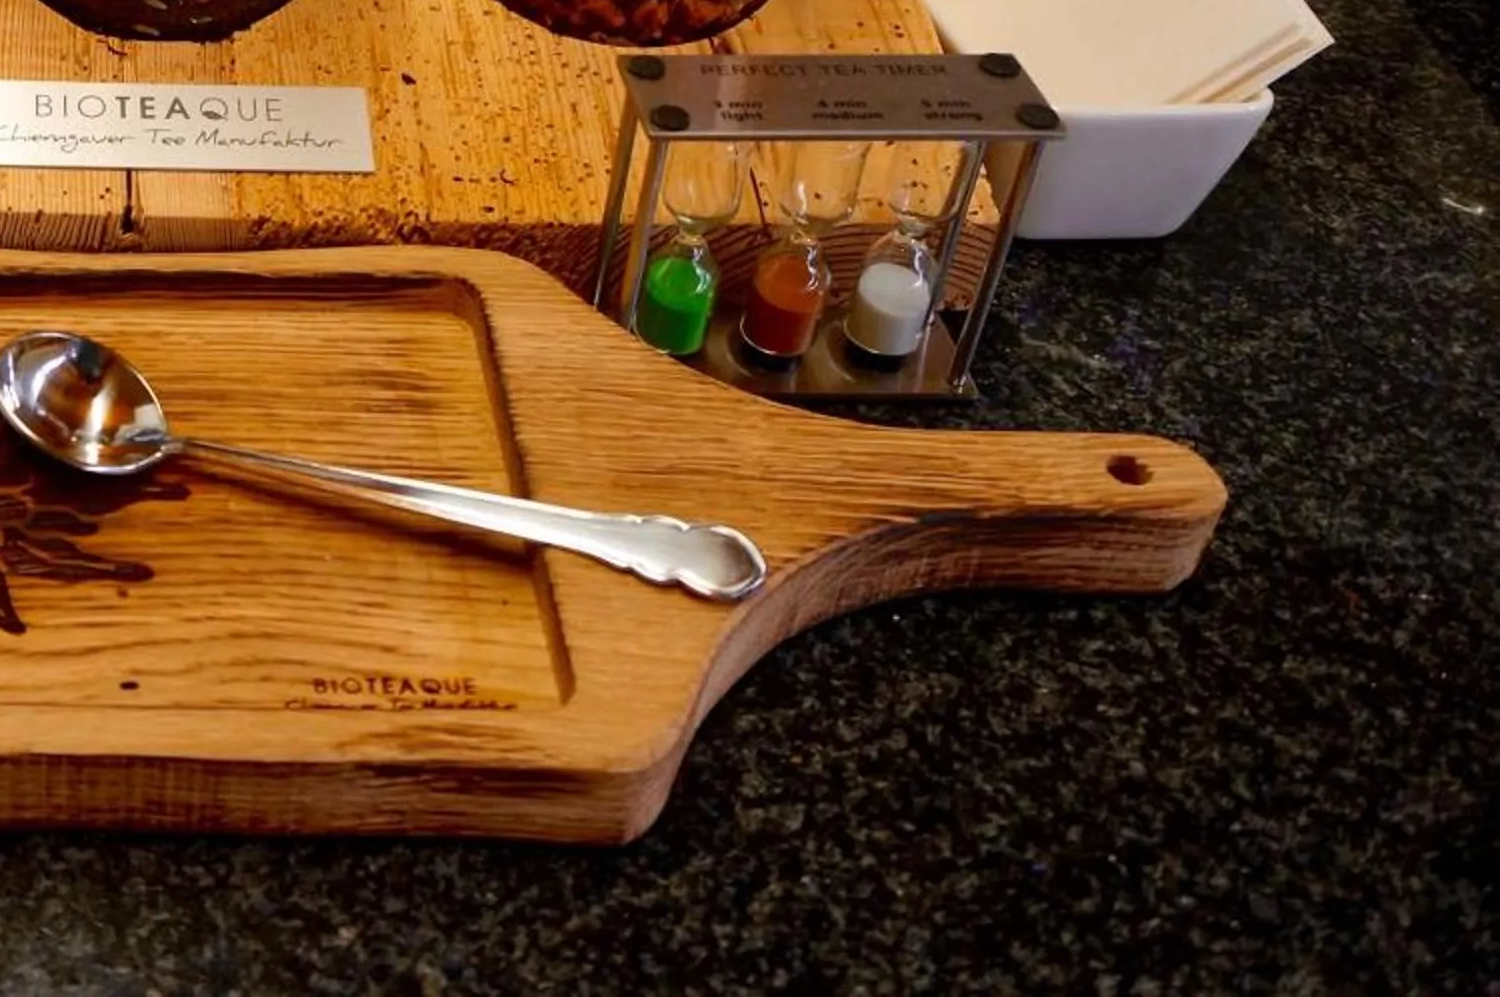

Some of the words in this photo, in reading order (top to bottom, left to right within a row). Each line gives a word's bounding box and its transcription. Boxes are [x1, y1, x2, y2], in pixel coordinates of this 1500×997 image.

[699, 63, 808, 78] PERFECT
[819, 63, 867, 78] TEA
[34, 93, 285, 123] BIOTEAQUE
[146, 127, 187, 149] Tee
[312, 676, 478, 696] BIOTEAQUE
